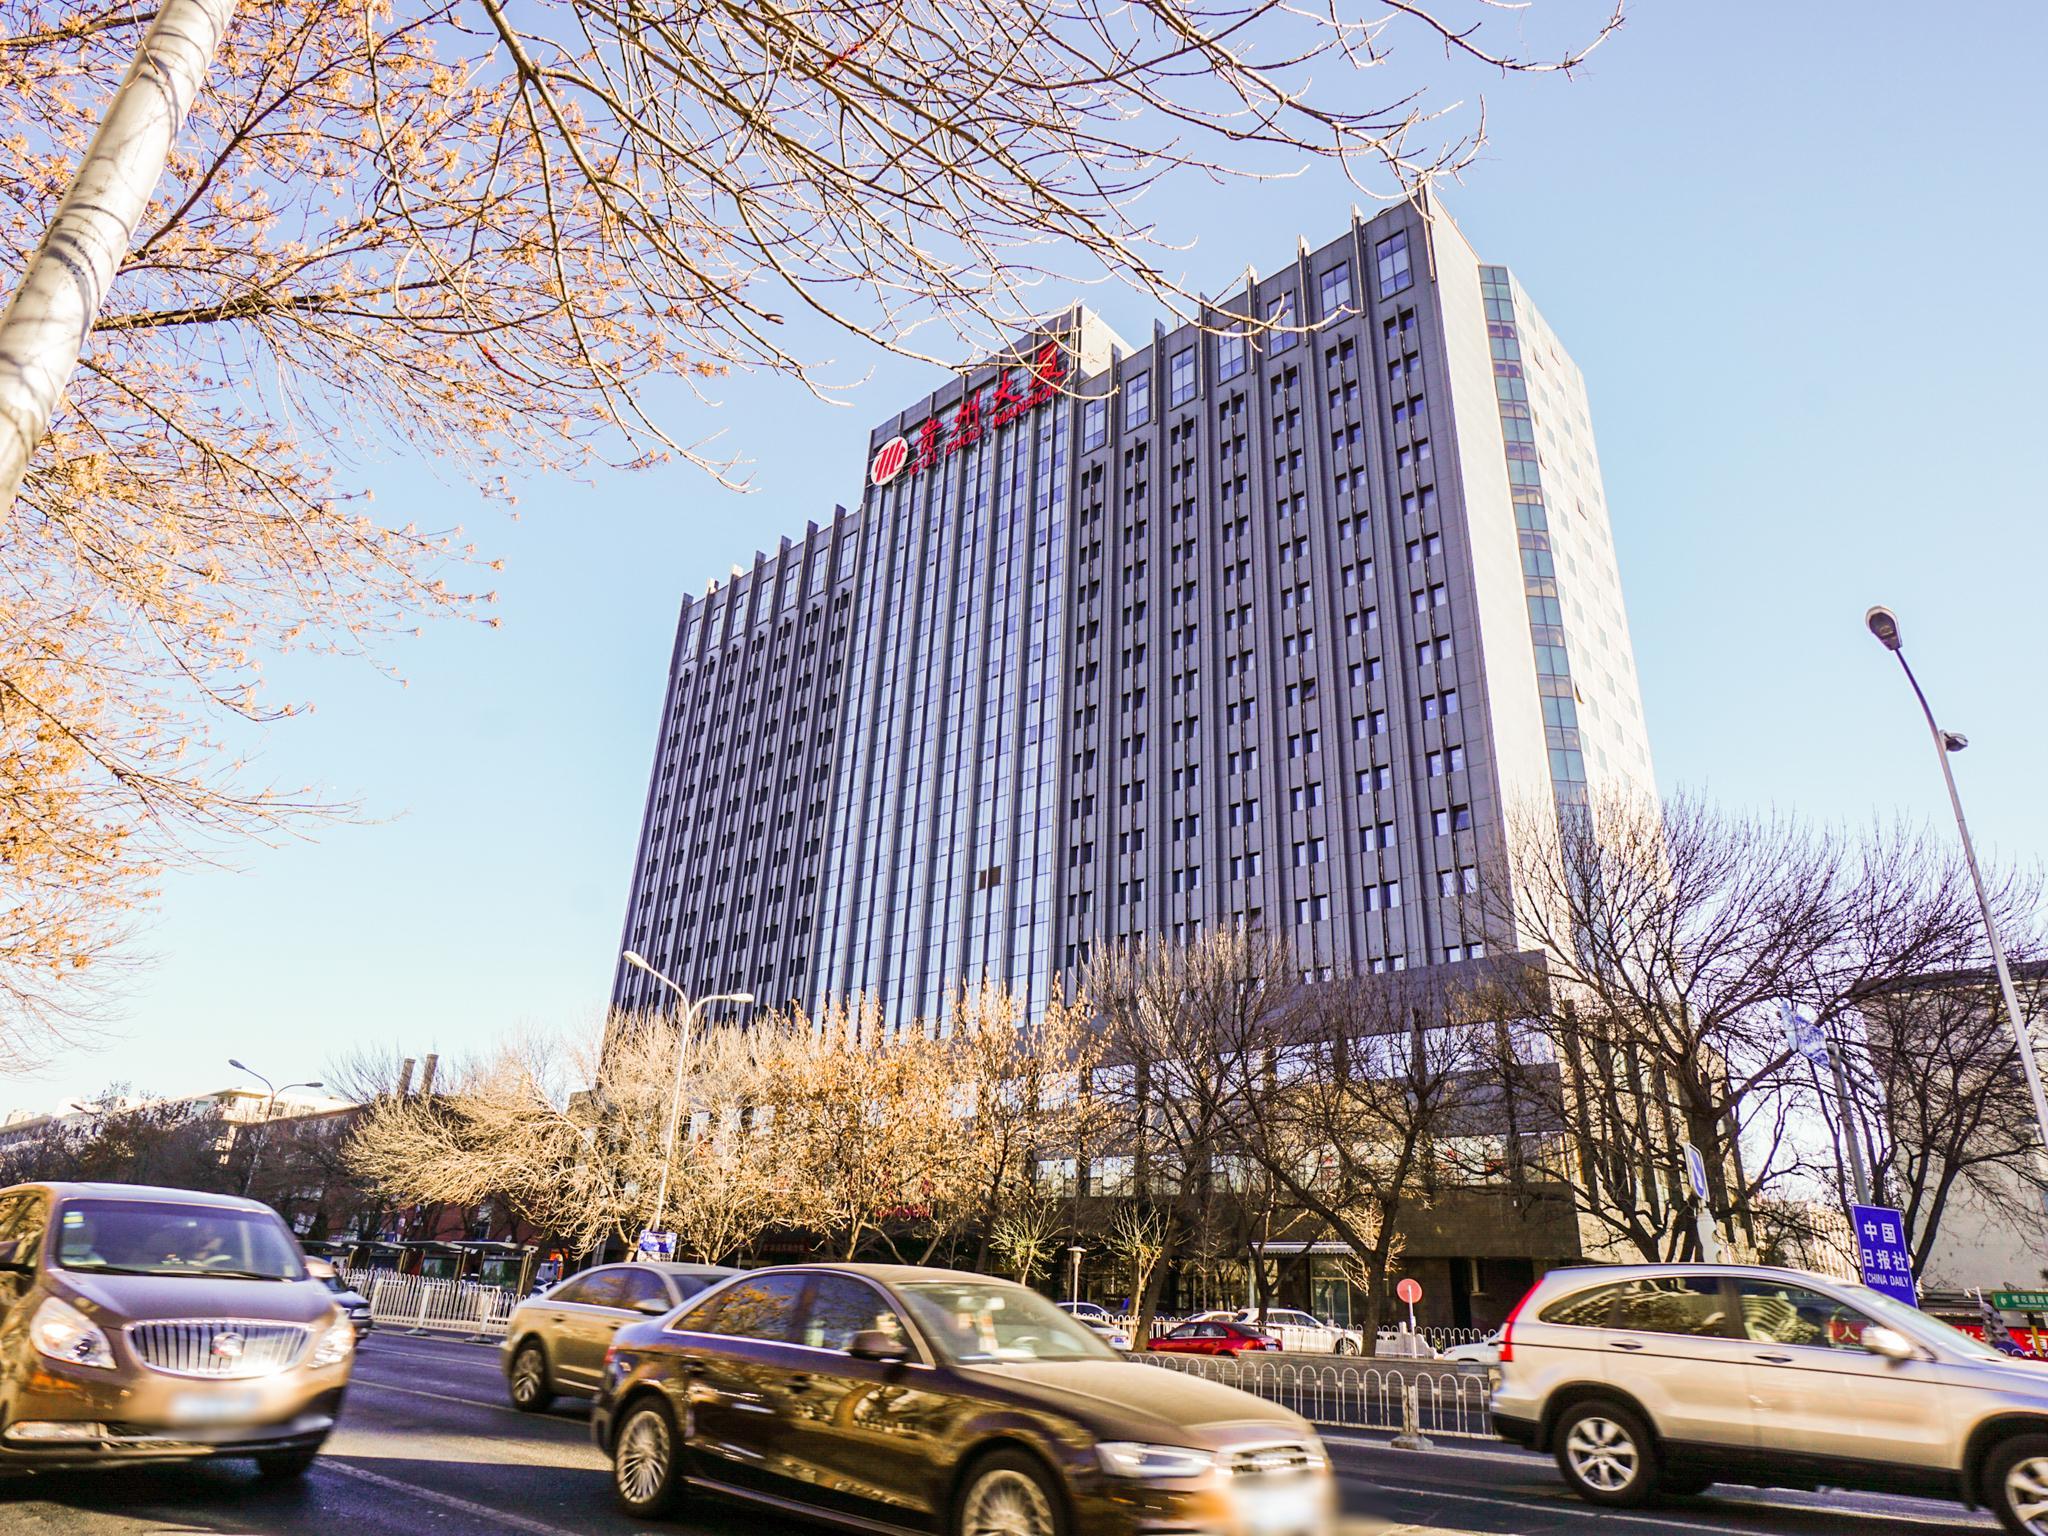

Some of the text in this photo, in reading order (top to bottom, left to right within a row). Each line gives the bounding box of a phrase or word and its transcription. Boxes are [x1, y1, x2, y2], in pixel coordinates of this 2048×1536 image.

[914, 341, 1067, 458] 贵州大厦
[909, 380, 1061, 475] GUI ZHOU MANSION
[1864, 1221, 1896, 1244] 中国
[1863, 1249, 1907, 1271] 日报社
[1867, 1272, 1909, 1287] CHINA DAILY
